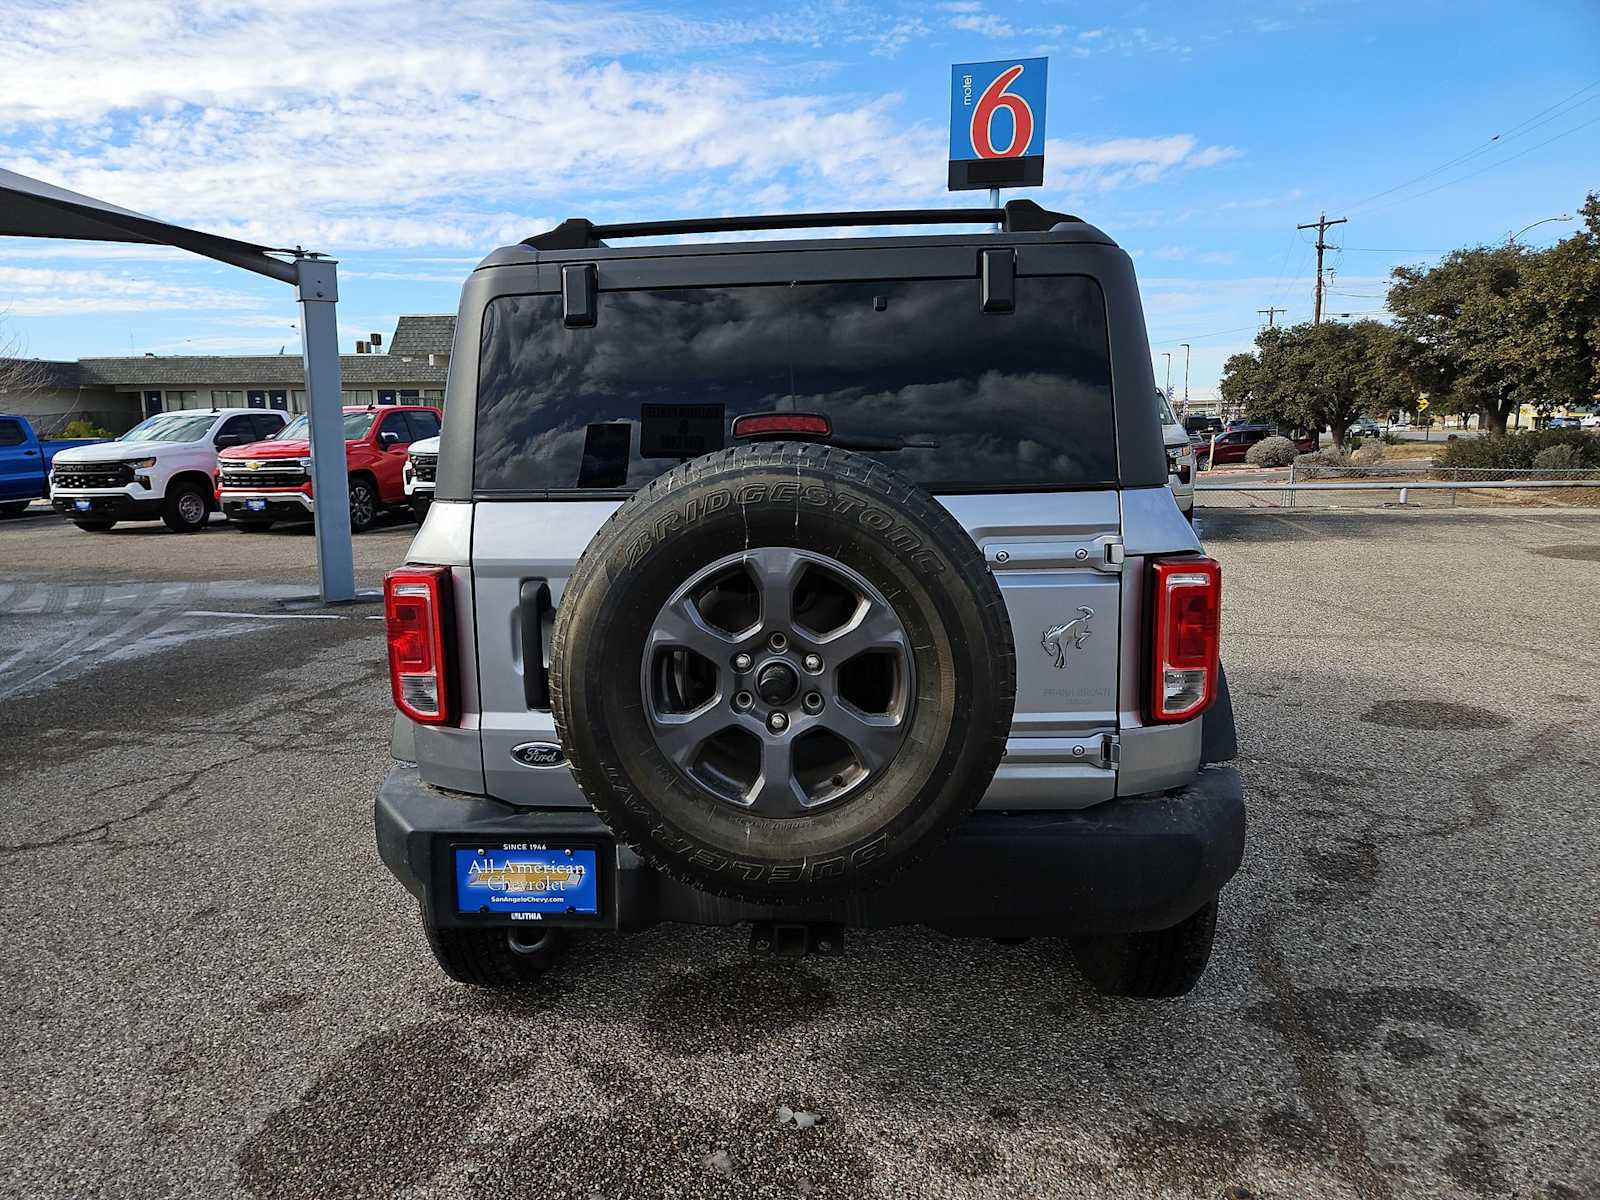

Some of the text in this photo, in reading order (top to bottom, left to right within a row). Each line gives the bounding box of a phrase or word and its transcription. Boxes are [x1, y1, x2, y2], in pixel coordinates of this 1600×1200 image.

[962, 73, 972, 106] motel
[970, 64, 1034, 159] 6
[625, 482, 946, 571] BRIDGESTONE
[524, 747, 557, 762] Ford
[468, 858, 586, 874] All American
[487, 875, 566, 892] Chevrolet
